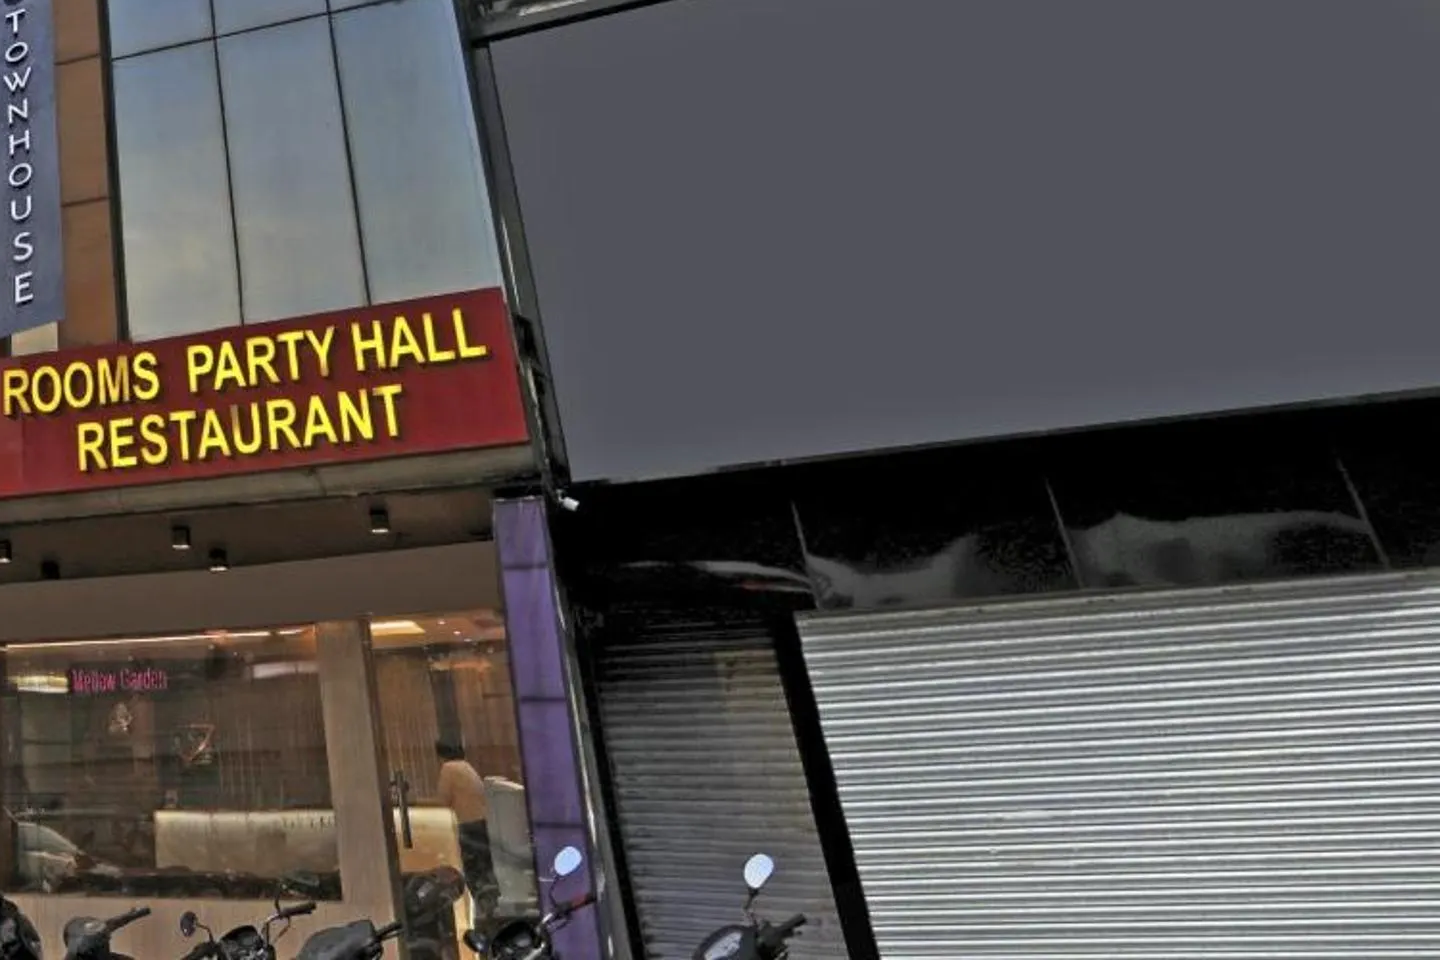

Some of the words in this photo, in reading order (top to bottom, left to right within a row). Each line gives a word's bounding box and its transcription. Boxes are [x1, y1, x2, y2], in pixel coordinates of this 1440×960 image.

[3, 9, 33, 304] TOWNHOUSE
[2, 351, 160, 416] ROOMS
[186, 326, 335, 393] PARTY
[351, 307, 487, 372] HALL
[77, 383, 403, 472] RESTAURANT
